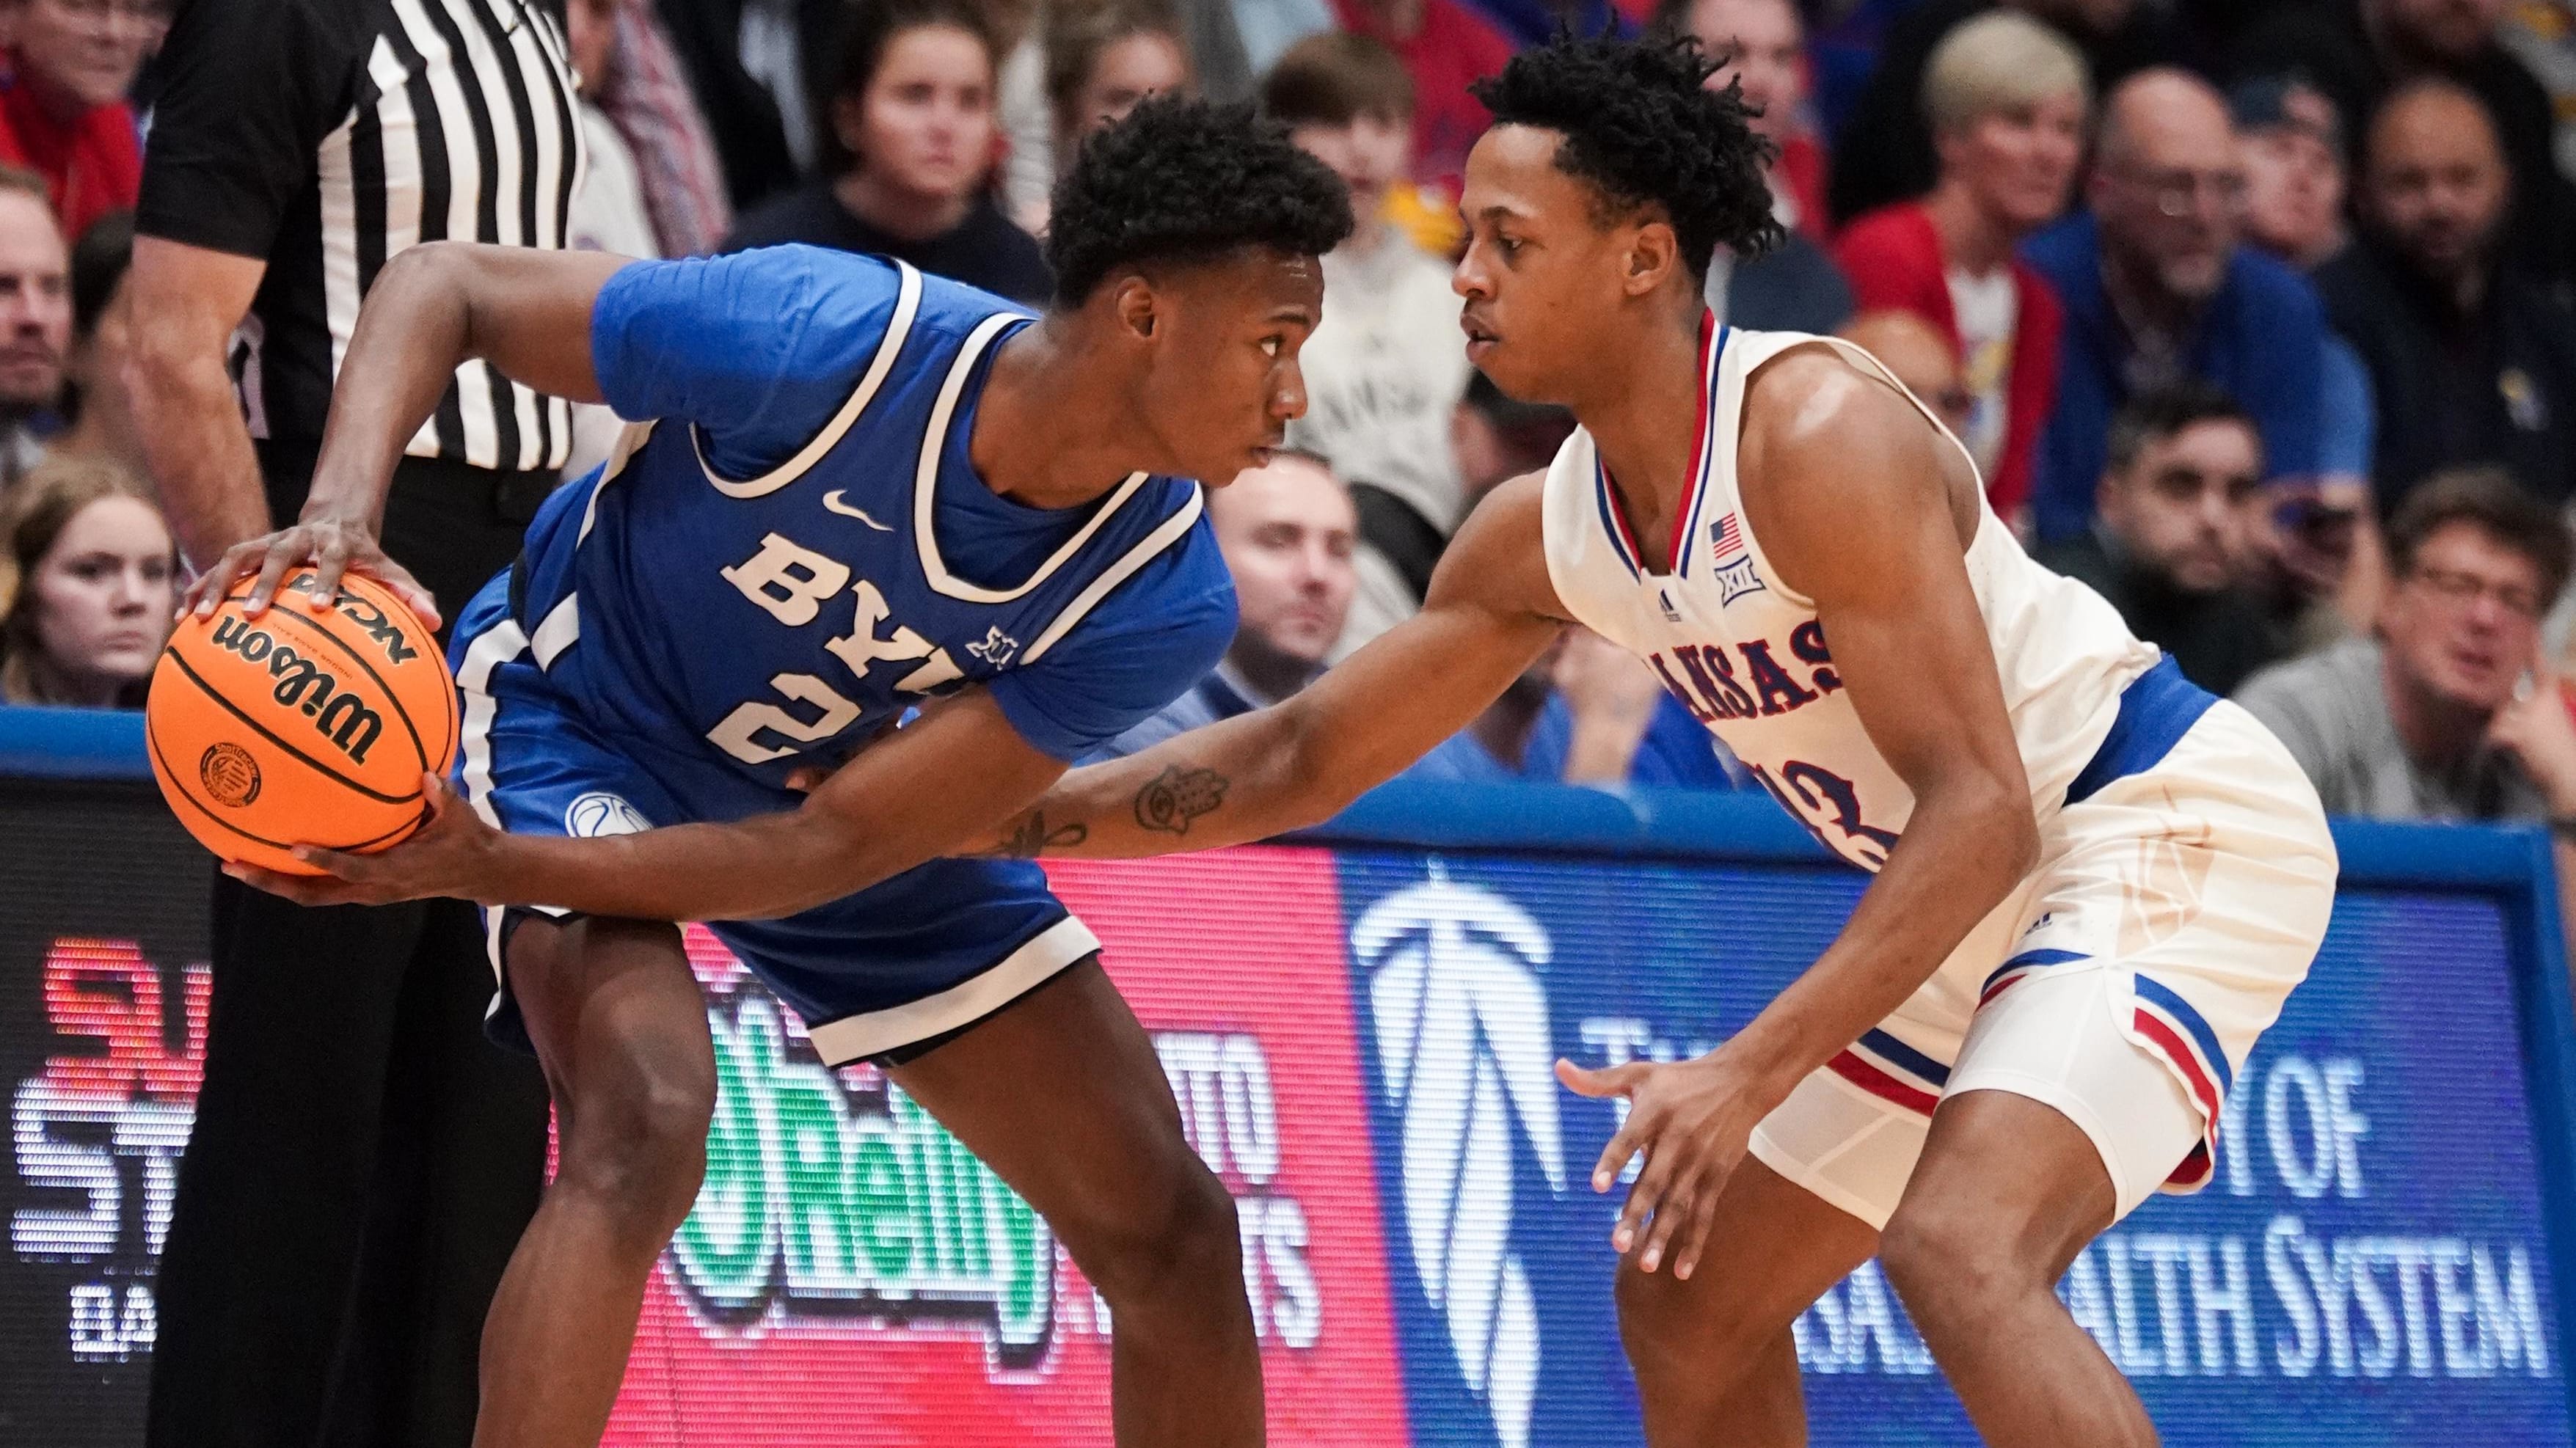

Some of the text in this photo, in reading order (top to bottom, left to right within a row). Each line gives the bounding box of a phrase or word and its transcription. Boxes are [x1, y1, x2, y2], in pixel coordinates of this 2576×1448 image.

[211, 615, 382, 767] Wilson
[706, 673, 862, 764] 2
[2265, 1056, 2372, 1198] OF
[2264, 1215, 2550, 1378] SYSTEM
